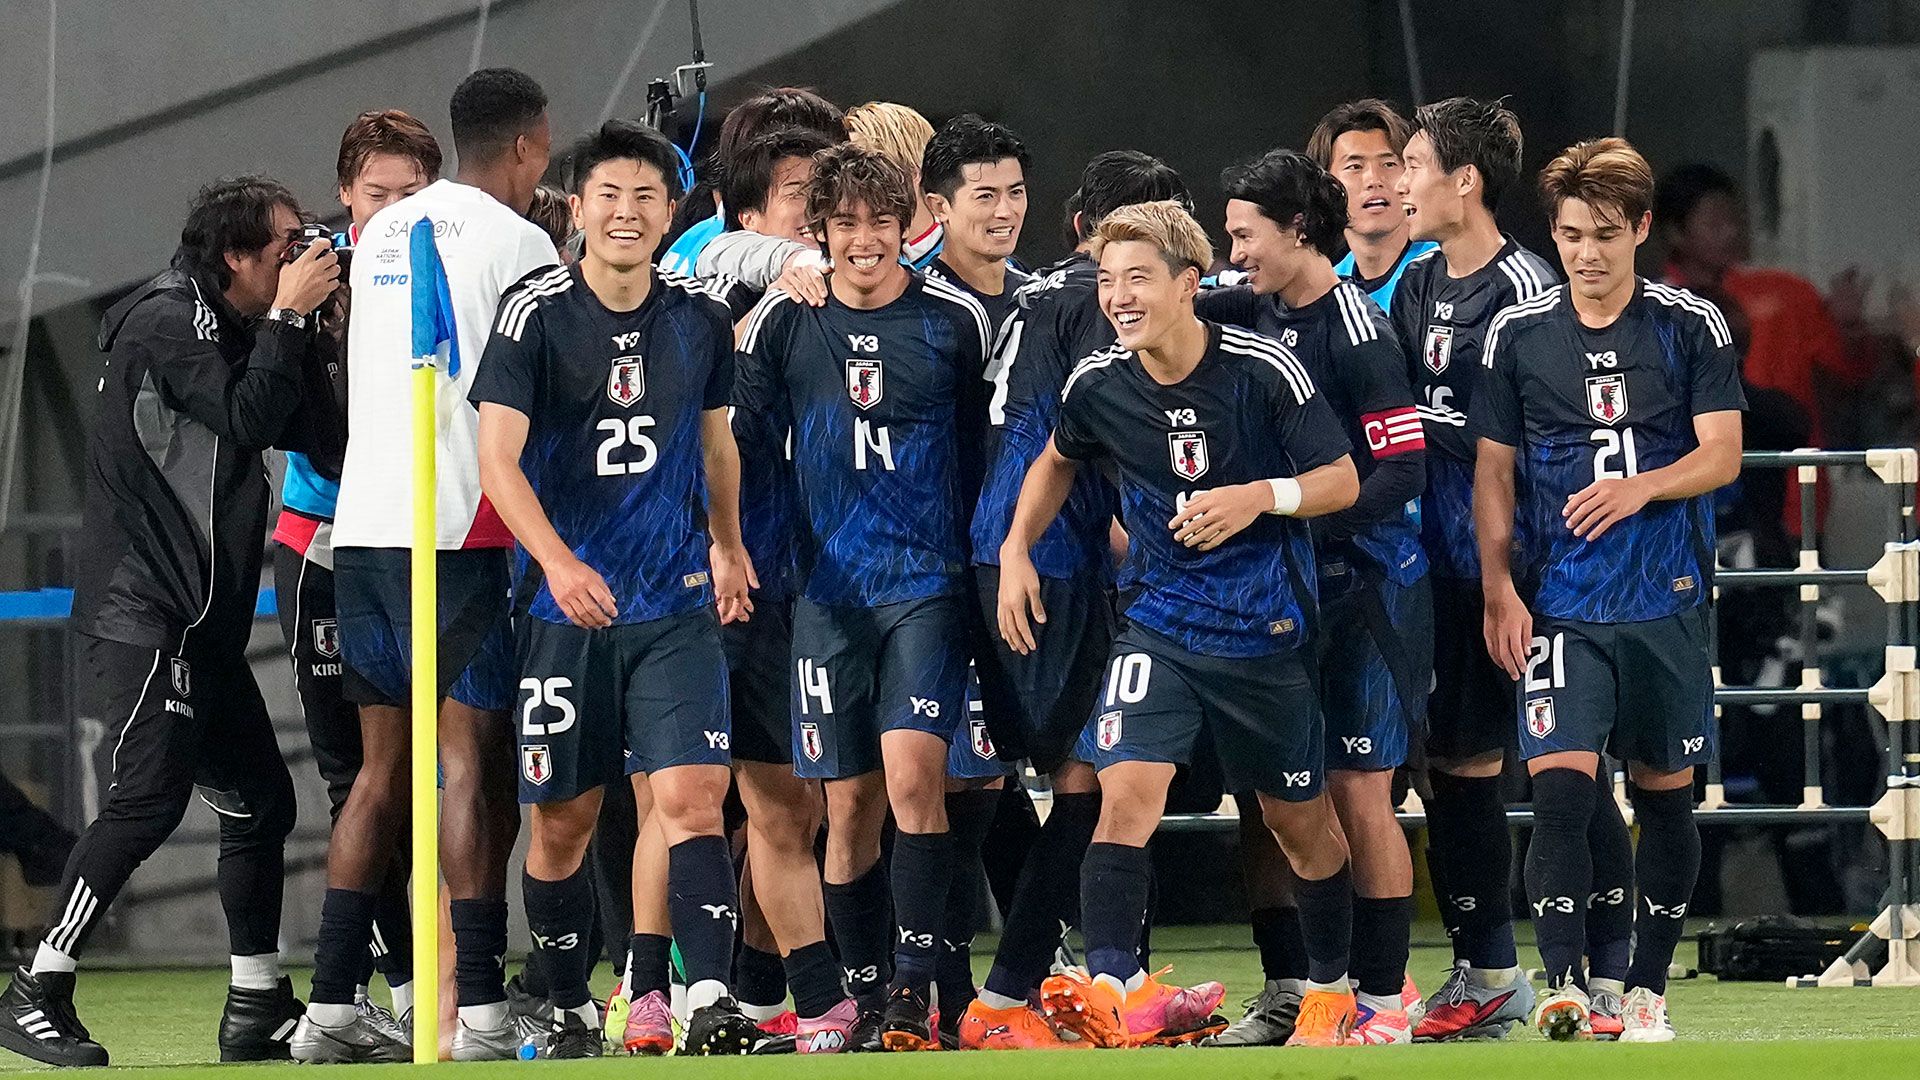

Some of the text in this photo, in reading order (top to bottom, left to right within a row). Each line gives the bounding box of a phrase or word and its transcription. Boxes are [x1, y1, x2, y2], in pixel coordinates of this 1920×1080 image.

[373, 274, 409, 286] TOYO
[1434, 301, 1454, 321] Y-3
[611, 331, 641, 351] Y-3
[847, 334, 879, 352] Y-3
[1585, 350, 1618, 370] Y-3
[1164, 408, 1197, 428] Y-3
[596, 415, 658, 476] 25
[854, 416, 896, 471] 14
[1365, 420, 1387, 451] C
[1590, 426, 1638, 482] 21
[311, 663, 343, 676] KIRI
[1525, 632, 1566, 693] 21
[798, 658, 834, 715] 14
[1105, 652, 1152, 707] 10
[165, 699, 194, 719] KIRIN
[519, 676, 576, 735] 25
[909, 696, 940, 718] Y-3
[703, 730, 730, 750] Y-3
[1341, 736, 1372, 754] Y-3
[1682, 736, 1704, 755] Y-3
[1282, 770, 1311, 787] Y-3
[1532, 896, 1574, 917] Y-3
[1644, 895, 1687, 919] Y-3
[530, 929, 578, 950] Y-3
[899, 925, 934, 949] Y-3
[843, 964, 878, 983] Y-3
